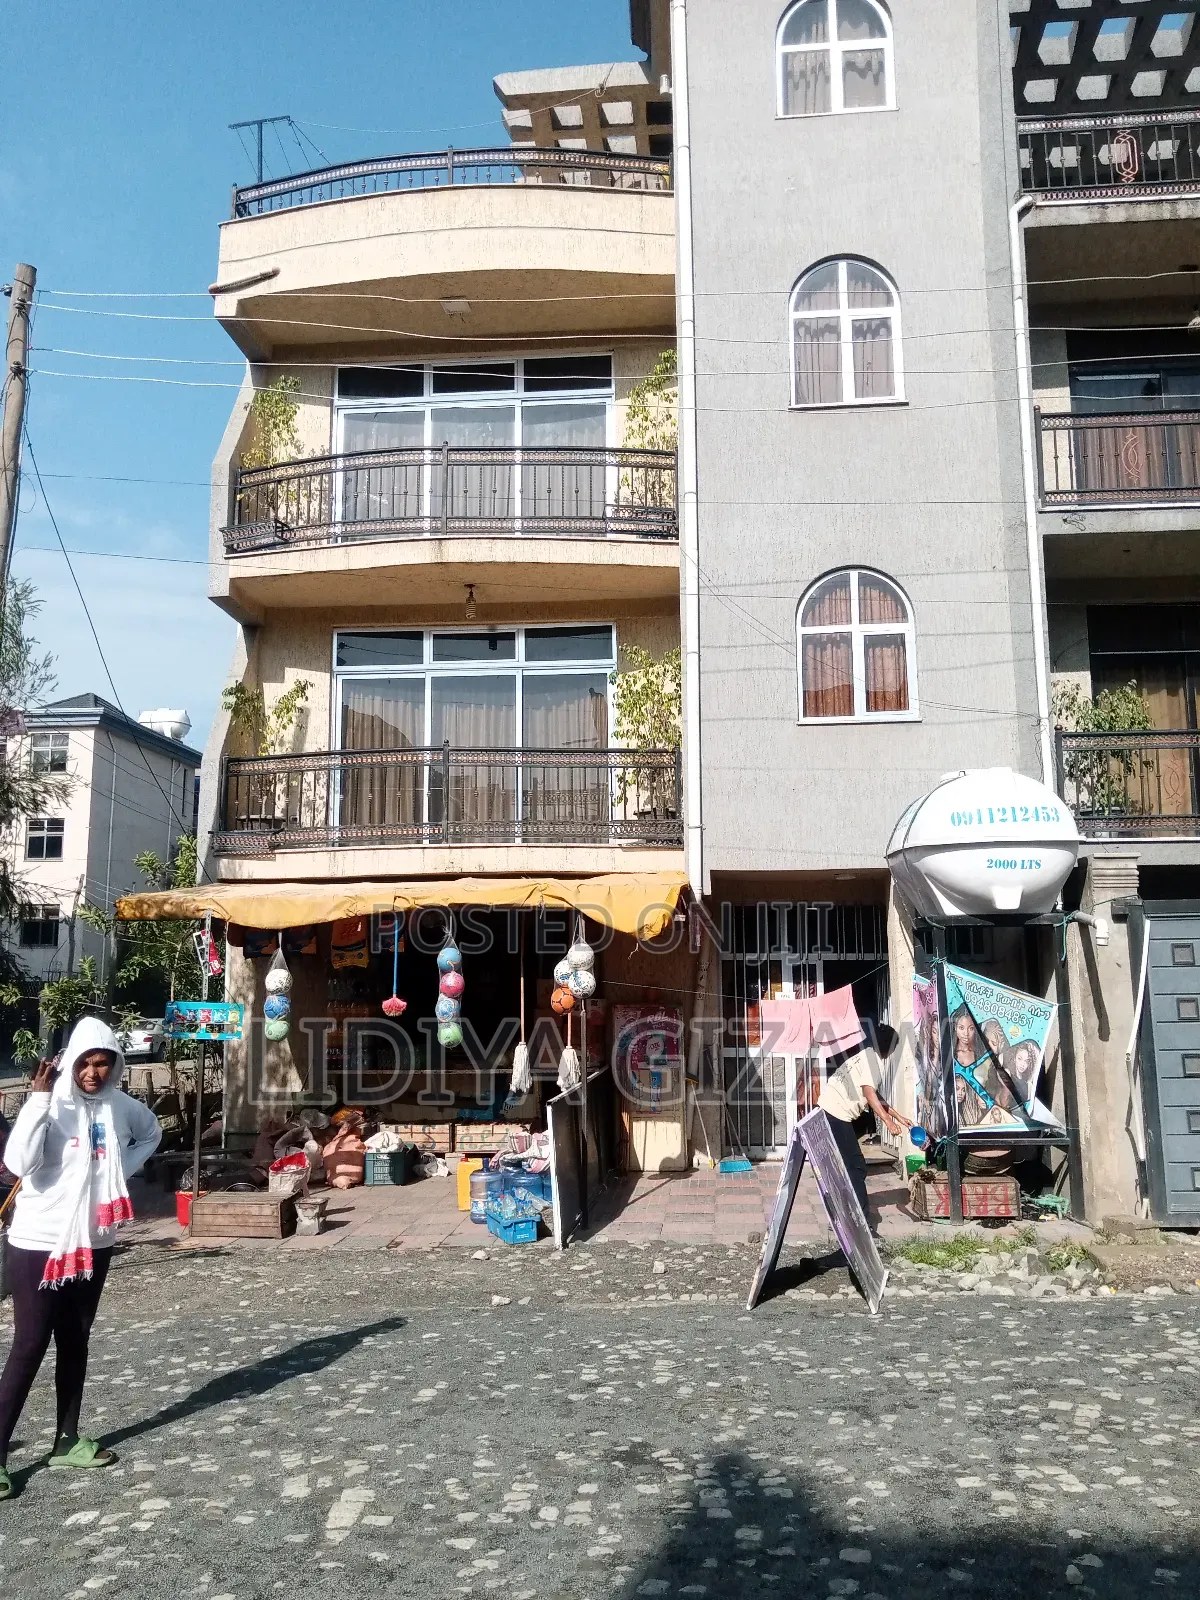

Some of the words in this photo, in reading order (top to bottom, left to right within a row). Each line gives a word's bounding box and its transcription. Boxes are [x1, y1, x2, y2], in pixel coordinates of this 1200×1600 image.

[950, 806, 1060, 826] 0911212453
[986, 858, 1017, 869] 2000
[1020, 859, 1041, 869] LTS
[964, 991, 1034, 1028] 0948084831
